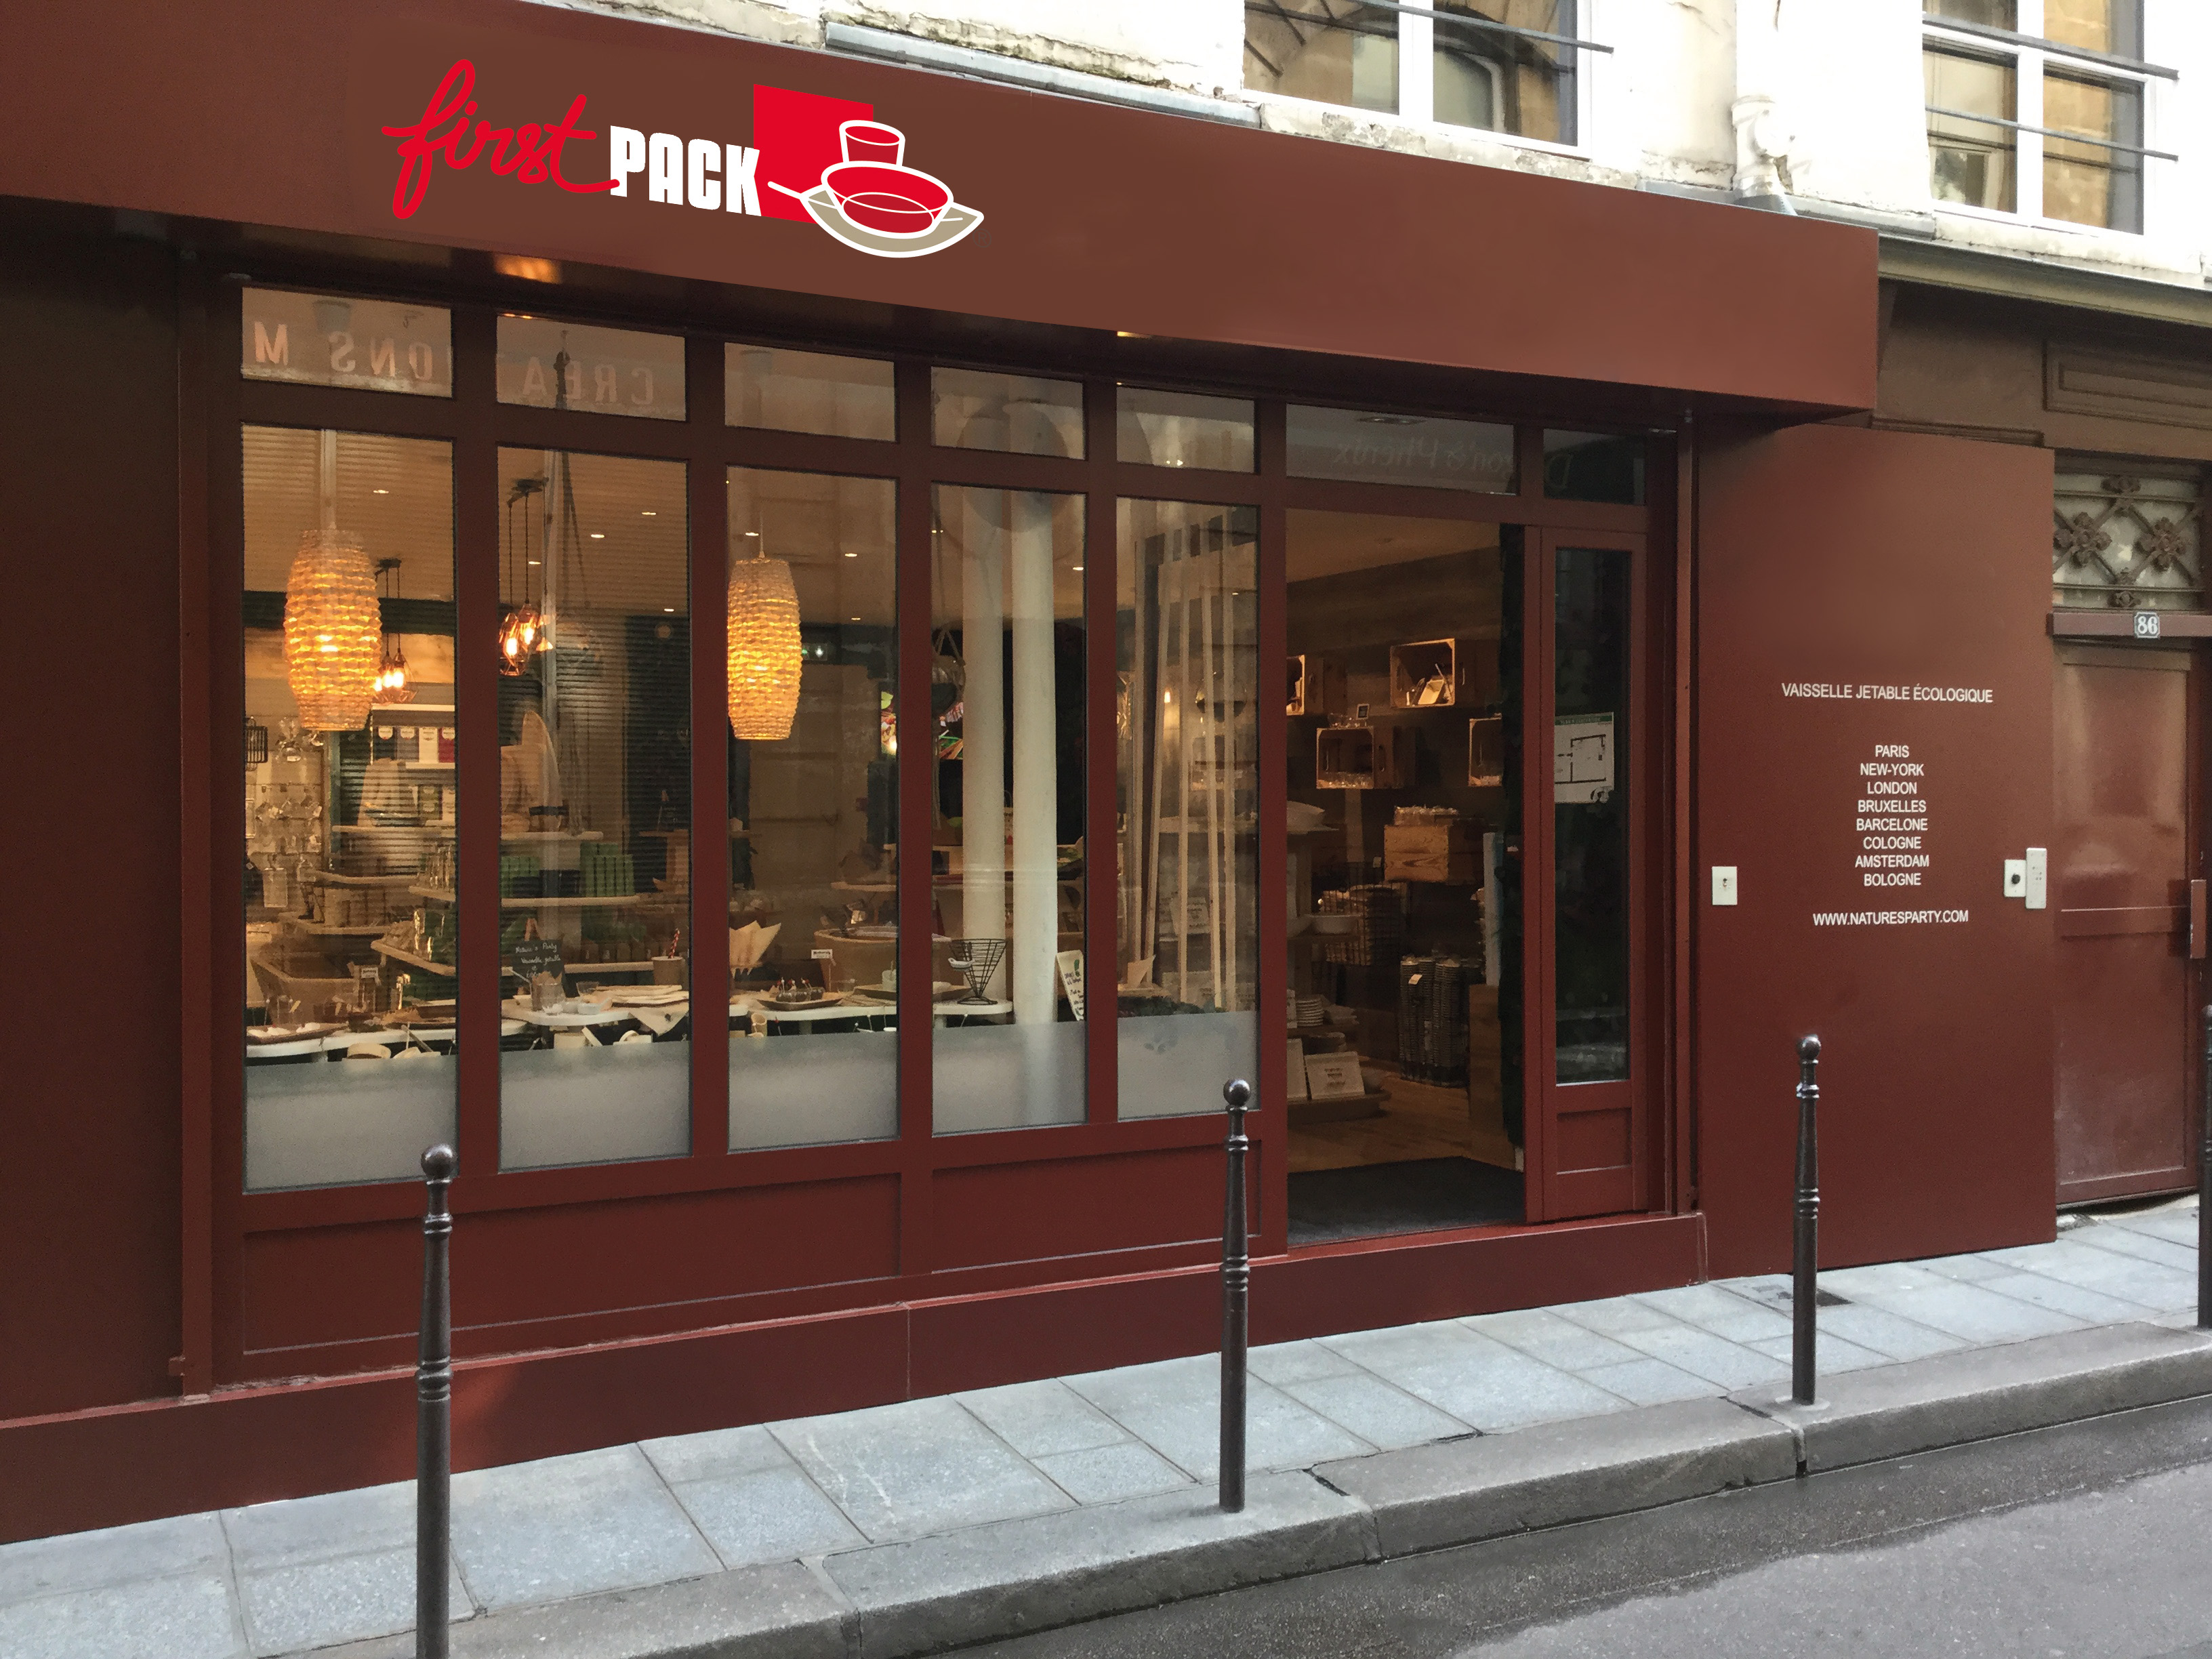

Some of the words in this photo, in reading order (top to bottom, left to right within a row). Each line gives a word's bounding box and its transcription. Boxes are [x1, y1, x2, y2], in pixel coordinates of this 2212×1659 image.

[382, 59, 620, 220] first
[611, 125, 762, 217] PACK
[2137, 615, 2158, 634] 86
[1782, 682, 1853, 699] VAISSELLE
[1856, 684, 1910, 700] JETABLE
[1913, 683, 1993, 703] ÉCOLOGIQUE
[1875, 744, 1910, 758] PARIS
[1860, 762, 1925, 776] NEW-YORK
[1867, 781, 1917, 794] LONDON
[1858, 800, 1927, 813] BRUXELLES
[1856, 818, 1928, 832] BARCELONE
[1863, 836, 1922, 850] COLOGNE
[1855, 854, 1929, 867] AMSTERDAM
[1864, 872, 1921, 886] BOLOGNE
[1812, 909, 1969, 926] WWW.NATURESPARTY.COM
